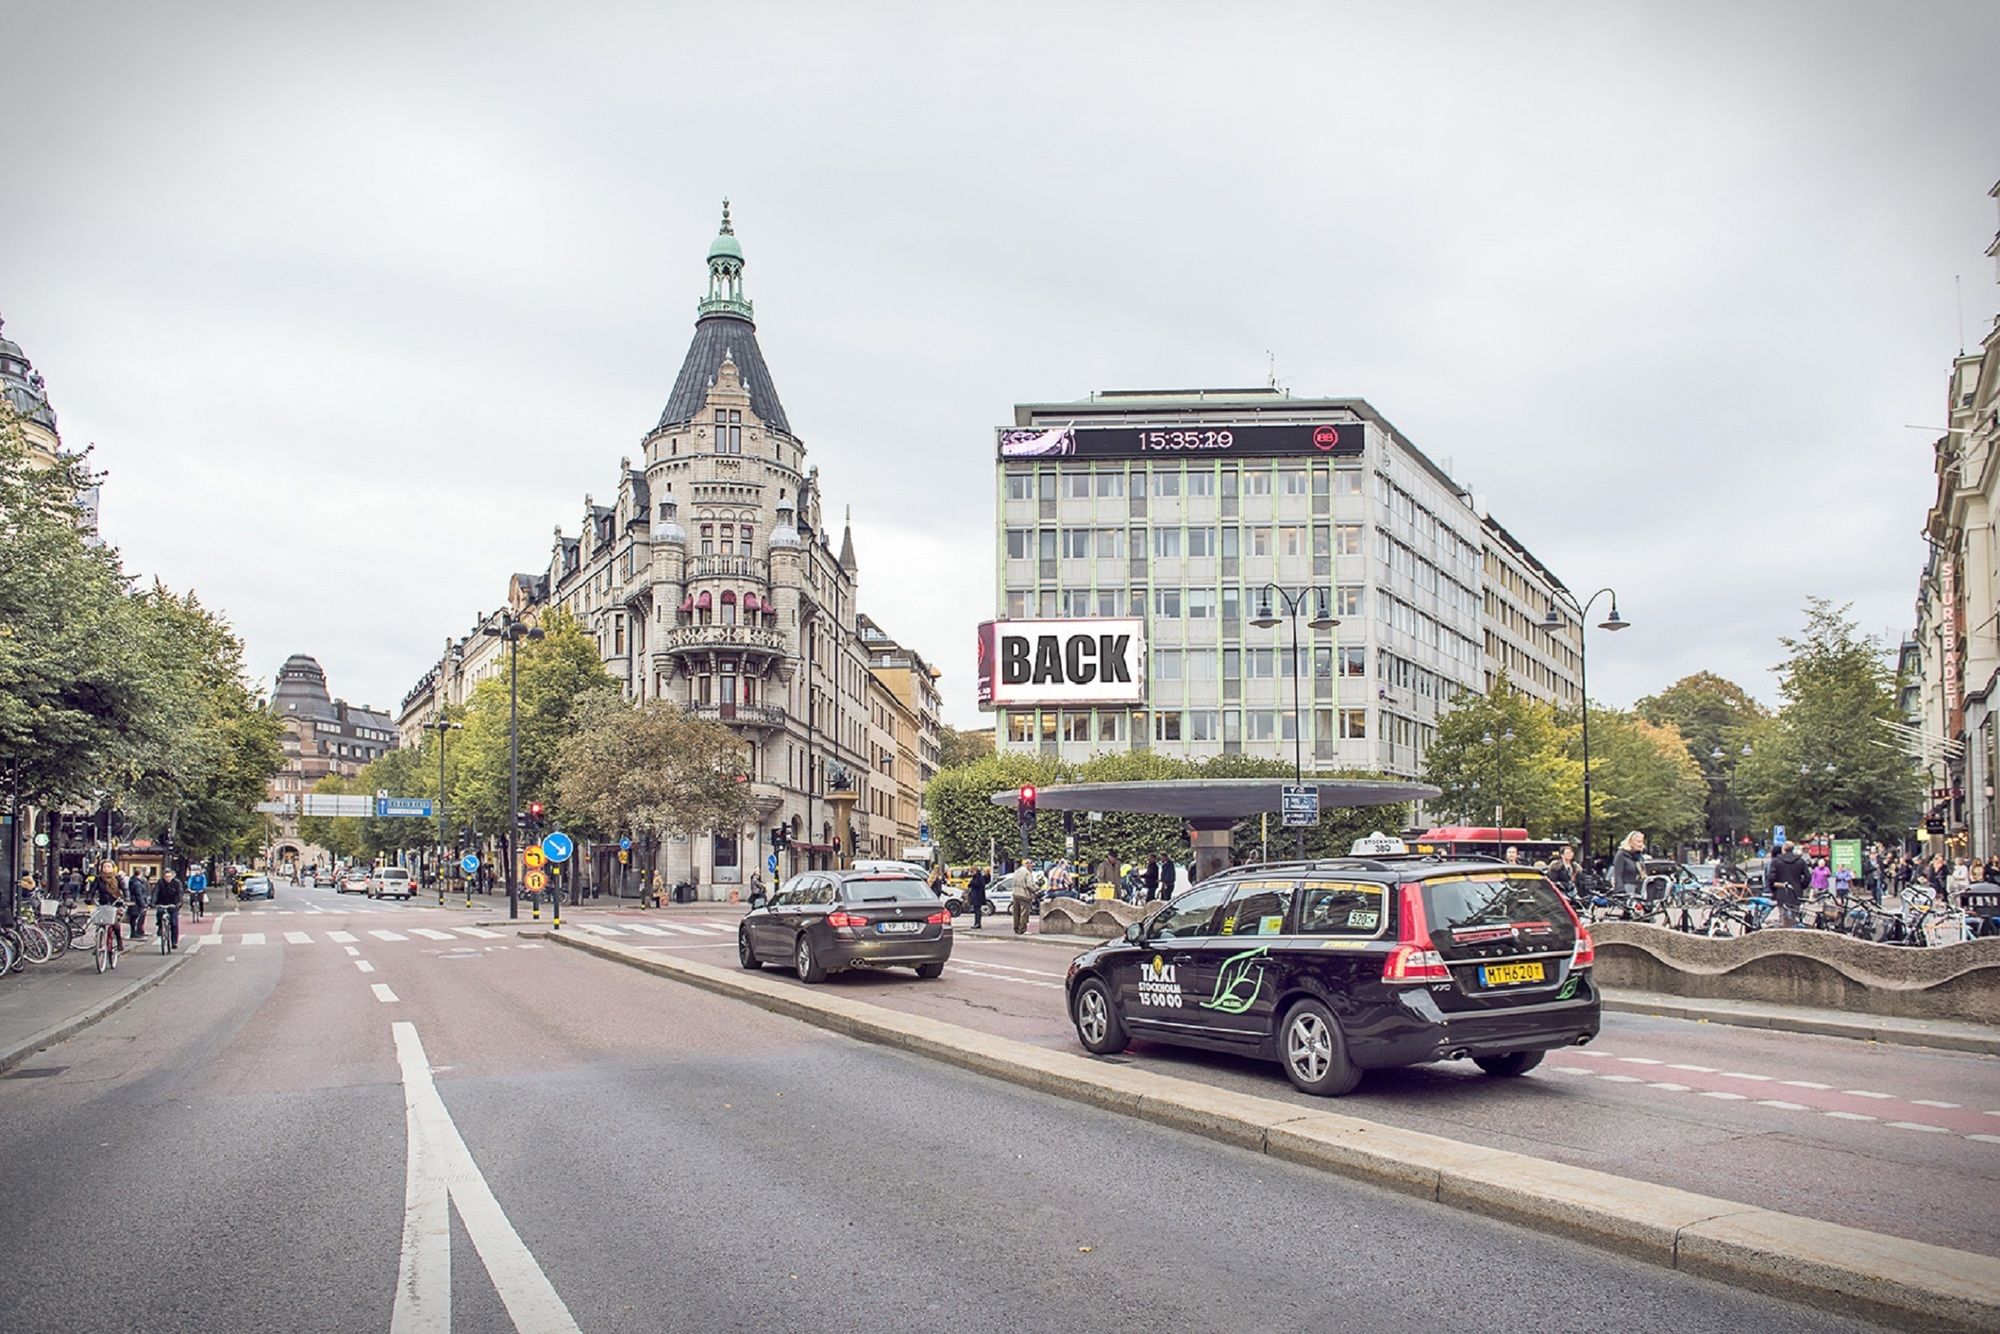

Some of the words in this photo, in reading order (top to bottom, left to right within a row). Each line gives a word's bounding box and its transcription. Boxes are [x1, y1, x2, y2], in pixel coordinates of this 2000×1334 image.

[1942, 562, 1957, 708] STUREBADET
[1001, 634, 1132, 685] BACK
[1479, 945, 1548, 957] VOLVO
[1140, 963, 1177, 983] TAXI
[1138, 982, 1182, 994] STOCKHOLM
